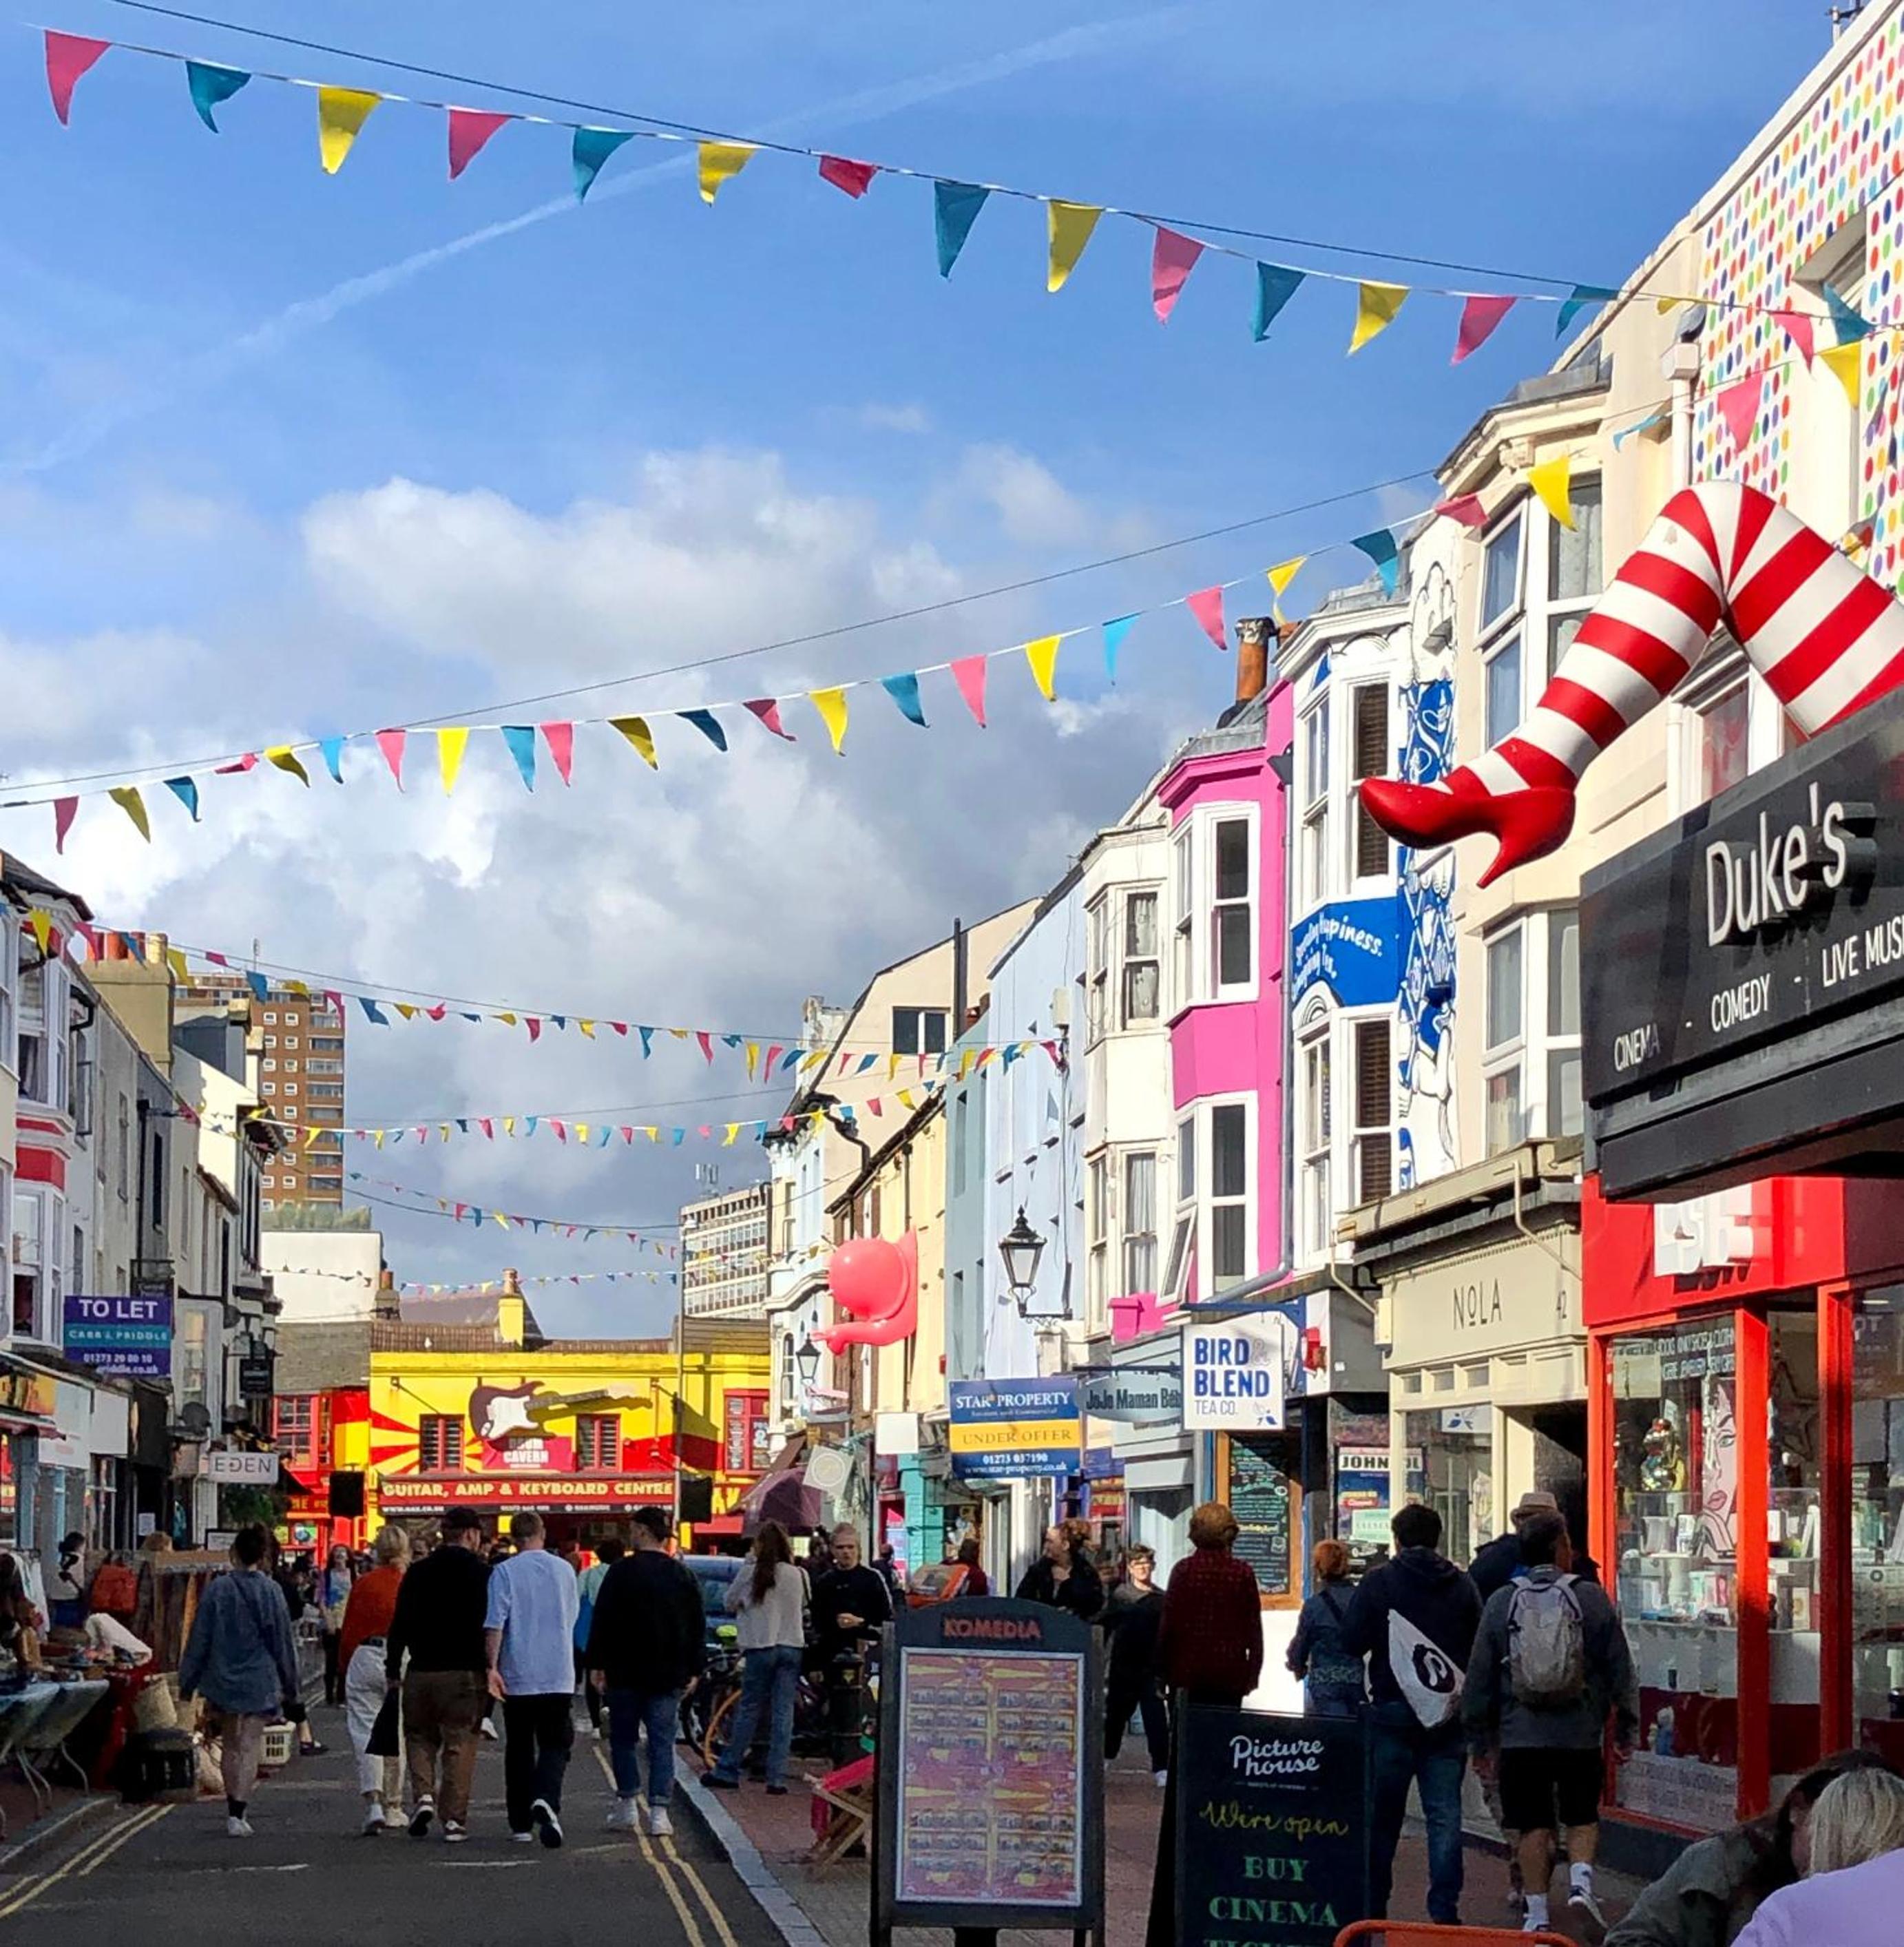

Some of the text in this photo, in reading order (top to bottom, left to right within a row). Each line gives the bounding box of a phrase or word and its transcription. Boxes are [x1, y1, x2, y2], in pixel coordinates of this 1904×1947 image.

[1706, 781, 1845, 947] Duke's
[1614, 1023, 1660, 1072] CINEMA
[1711, 972, 1770, 1032] COMEDY
[1823, 935, 1859, 987] LIVE
[79, 1299, 158, 1319] TO LET
[1453, 1278, 1502, 1330] NOLA
[1195, 1337, 1249, 1365] BIRD
[1194, 1369, 1270, 1397] BLEND
[996, 1392, 1069, 1407] PROPERTY
[1086, 1390, 1114, 1410] JoJo
[1116, 1388, 1158, 1409] Maman
[1194, 1399, 1217, 1415] TEA
[963, 1429, 1071, 1444] UNDER OFFER
[214, 1457, 272, 1472] EDEN
[503, 1450, 549, 1464] CAVERN
[1343, 1456, 1388, 1468] JOHN
[384, 1482, 673, 1498] GUITAR, AMP & KEYBOARD CENTRE
[944, 1619, 1041, 1638] KOMEDIA
[1230, 1735, 1324, 1769] Picture
[1245, 1757, 1320, 1776] house
[1199, 1800, 1349, 1842] We're open
[1244, 1856, 1309, 1881] BUY
[1209, 1897, 1339, 1927] CINEMA
